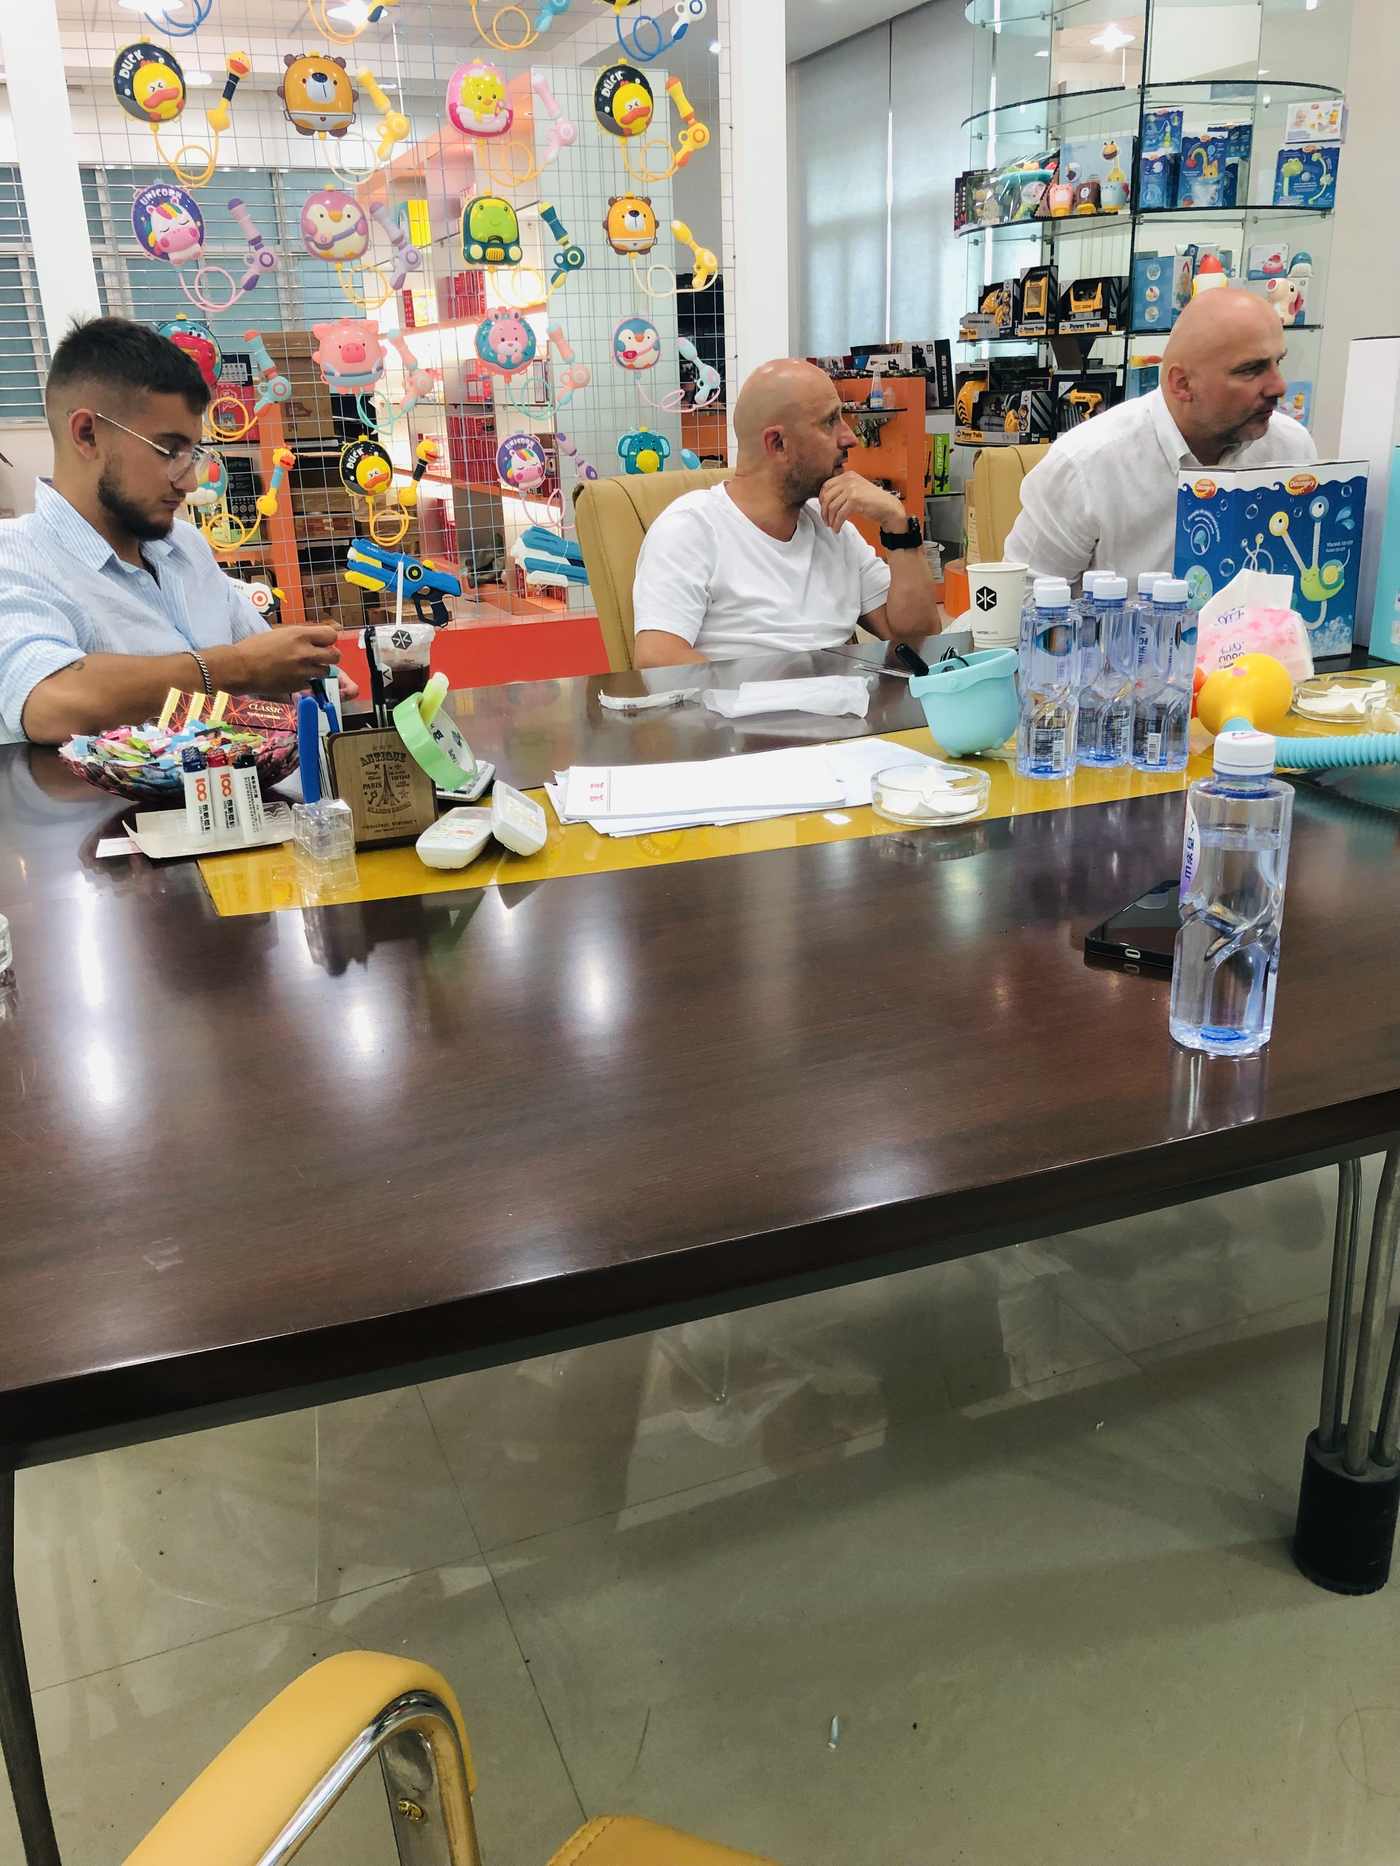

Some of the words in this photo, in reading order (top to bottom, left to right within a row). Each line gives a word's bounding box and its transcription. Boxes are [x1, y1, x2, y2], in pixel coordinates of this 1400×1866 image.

[119, 49, 144, 79] DUCK
[601, 70, 625, 98] DUCK
[139, 188, 183, 206] UNICORN
[346, 447, 365, 470] DUCK
[248, 703, 282, 714] CLASSIC
[1185, 836, 1195, 881] 百岁山
